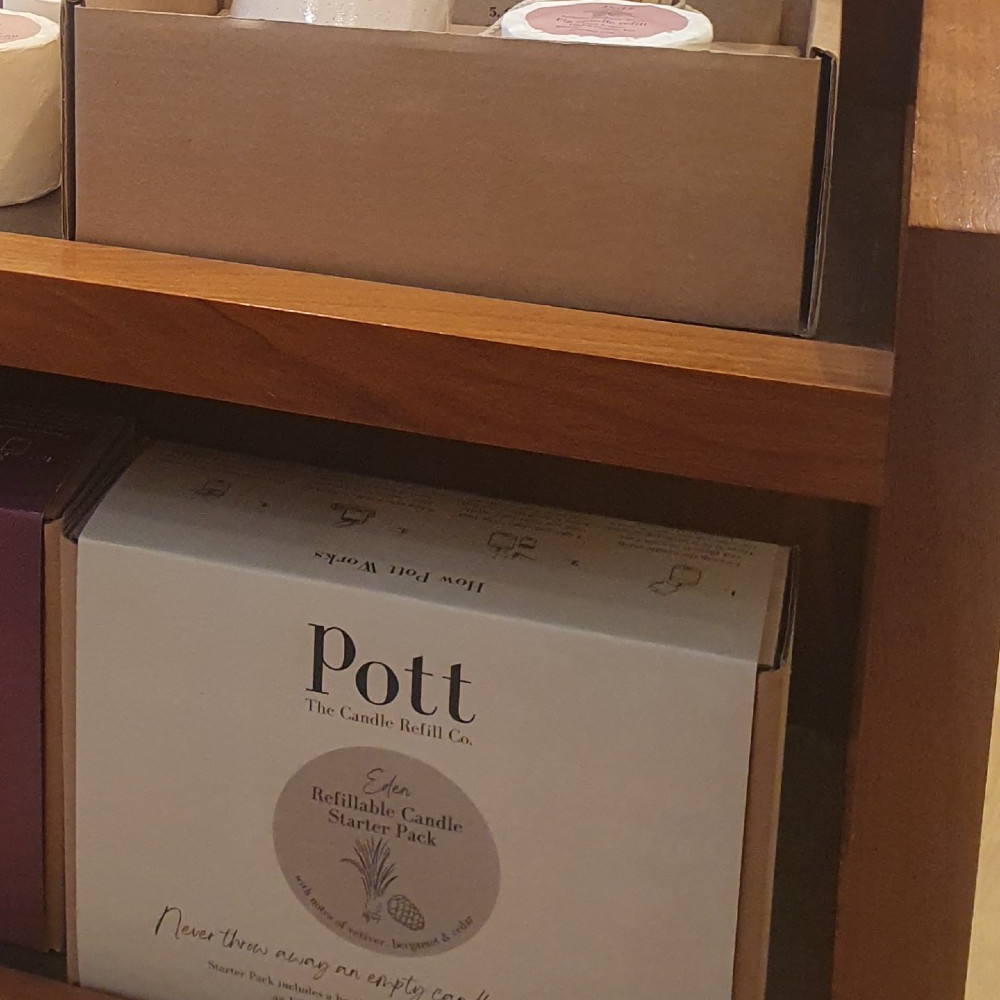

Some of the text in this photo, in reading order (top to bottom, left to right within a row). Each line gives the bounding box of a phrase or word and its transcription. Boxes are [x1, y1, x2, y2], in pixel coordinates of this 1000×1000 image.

[315, 552, 486, 593] How Pott Works
[306, 623, 476, 723] Pott
[305, 698, 472, 745] The Candle Refill Co.
[363, 768, 410, 798] Eden
[311, 786, 463, 833] Refillable Candle
[328, 809, 437, 847] Starter Pack
[154, 906, 425, 999] Never throw away an empty
